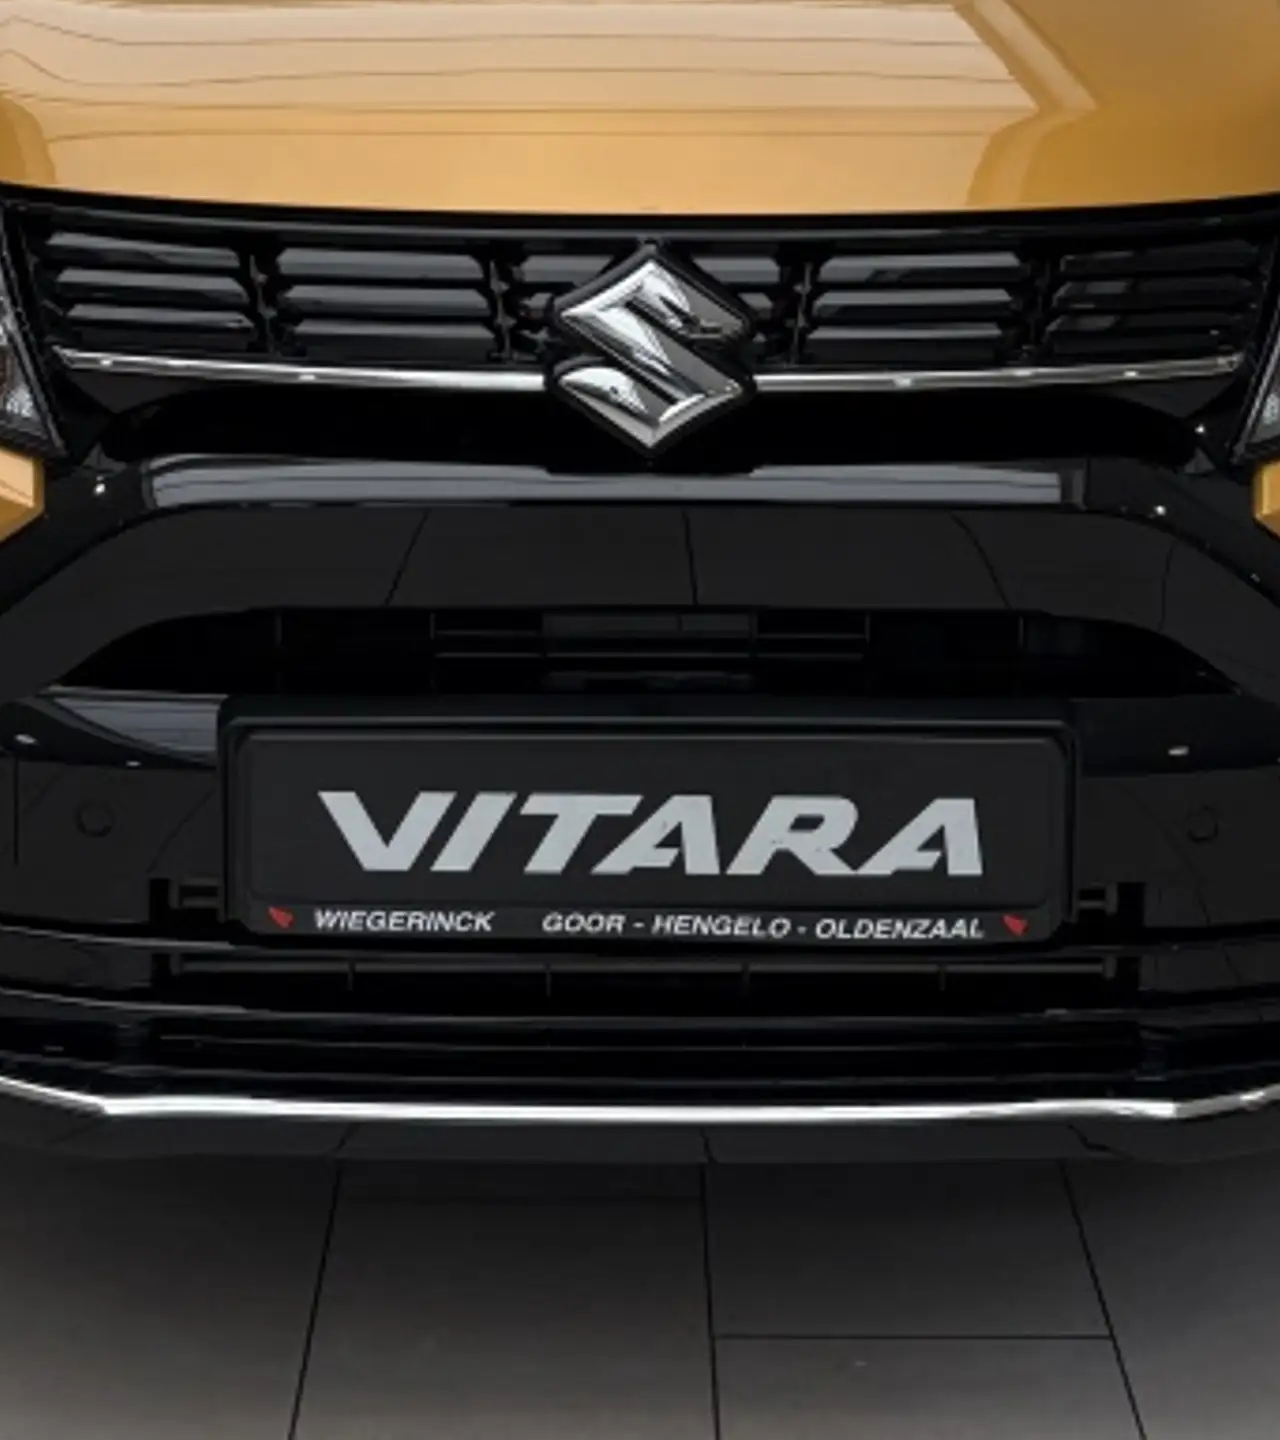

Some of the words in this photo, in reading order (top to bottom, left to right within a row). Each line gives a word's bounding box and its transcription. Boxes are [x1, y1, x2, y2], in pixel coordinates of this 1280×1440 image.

[318, 791, 984, 876] VITARA
[314, 908, 496, 933] WIEGERINCK
[541, 911, 626, 934] GOOR
[651, 914, 792, 939] HENGELO
[815, 917, 985, 940] OLDENZAAL
